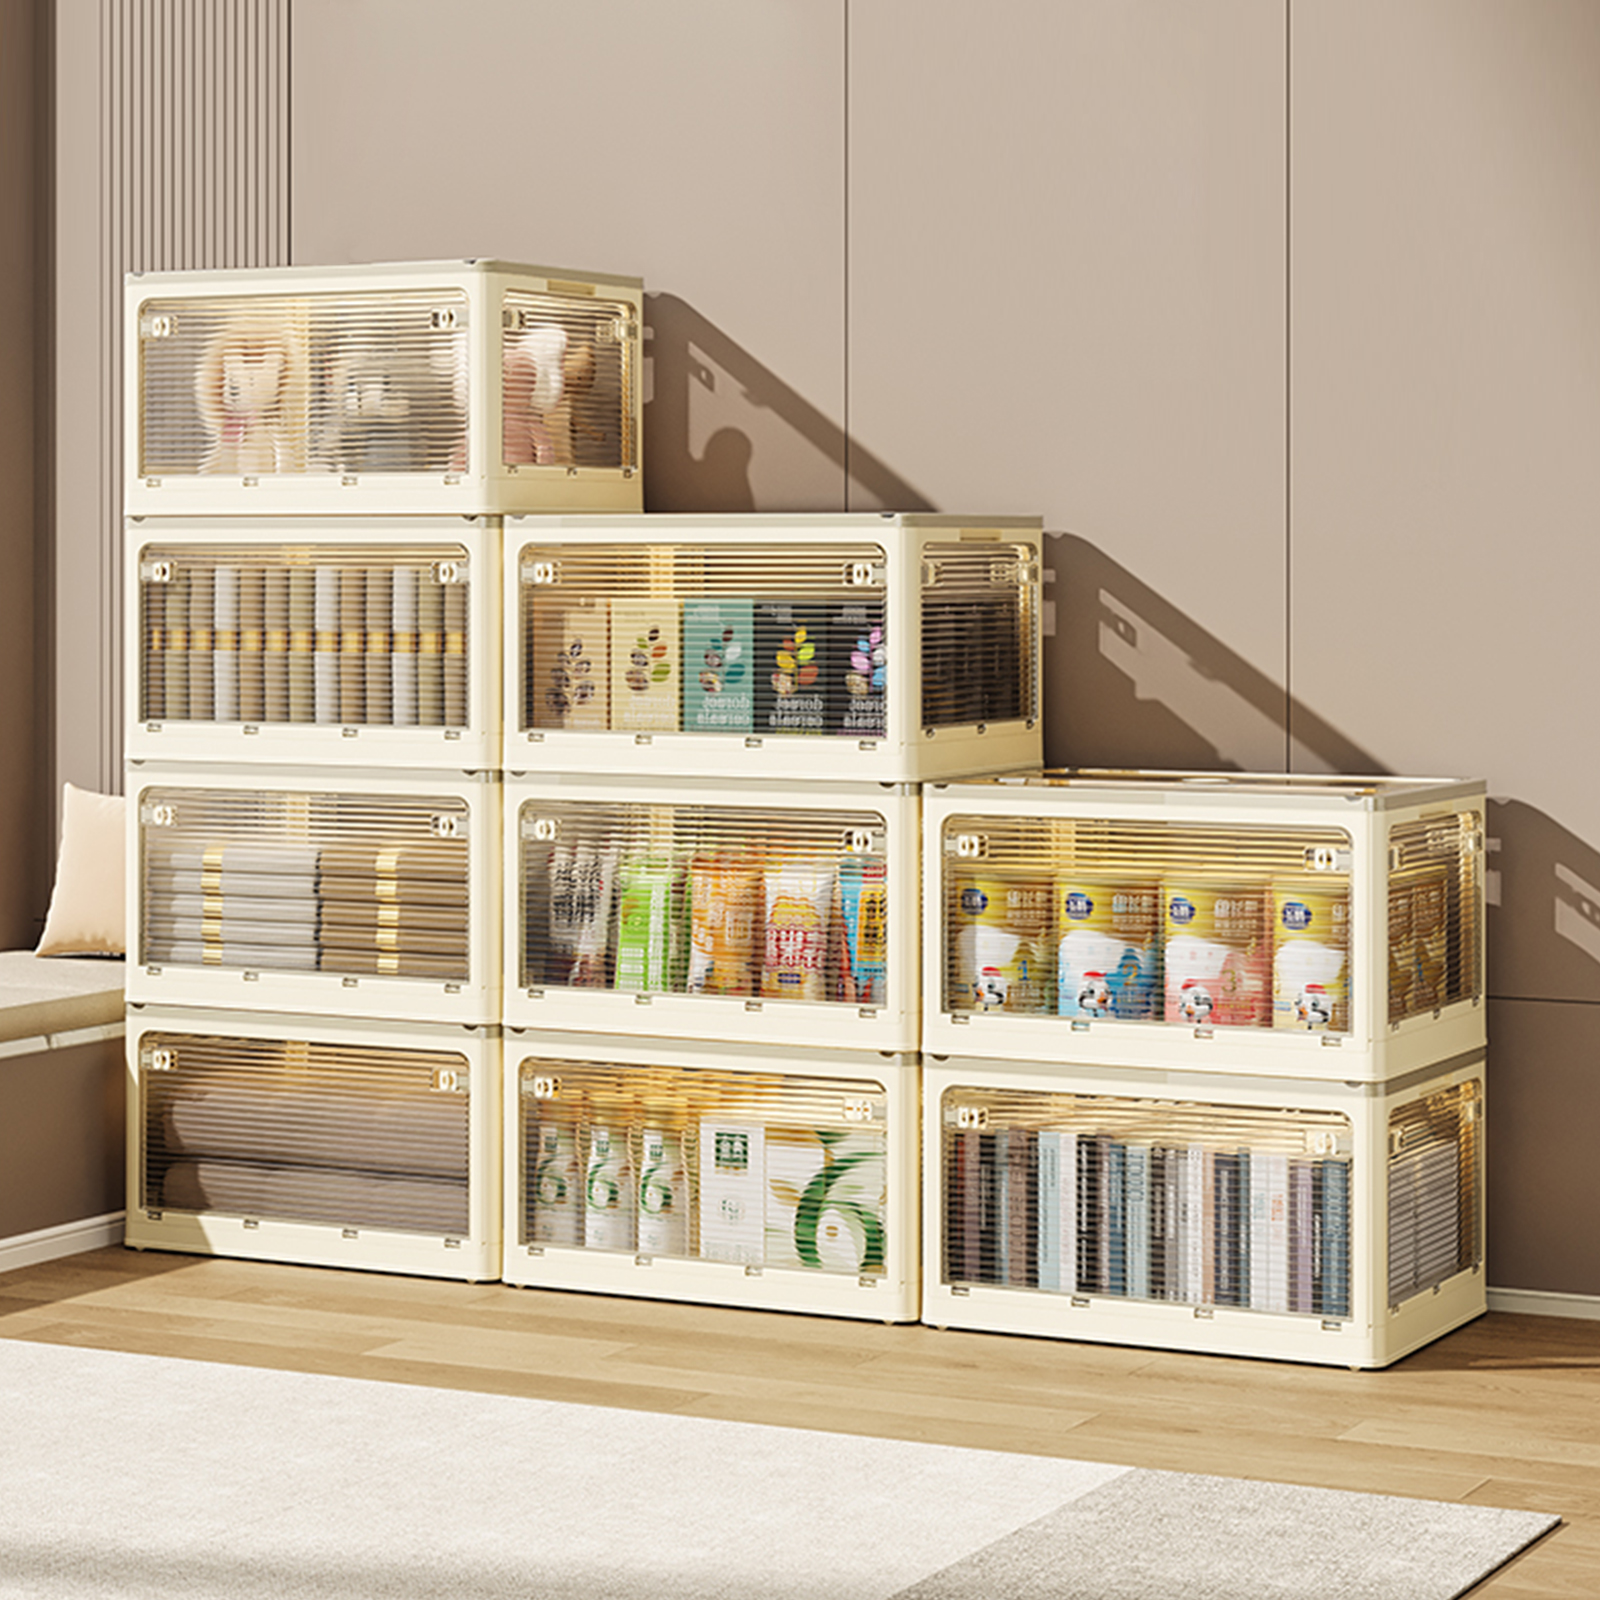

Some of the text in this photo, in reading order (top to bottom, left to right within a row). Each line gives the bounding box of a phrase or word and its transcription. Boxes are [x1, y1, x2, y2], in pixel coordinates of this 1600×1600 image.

[1018, 960, 1029, 982] 1
[1122, 964, 1138, 986] 2
[1222, 969, 1237, 994] 3
